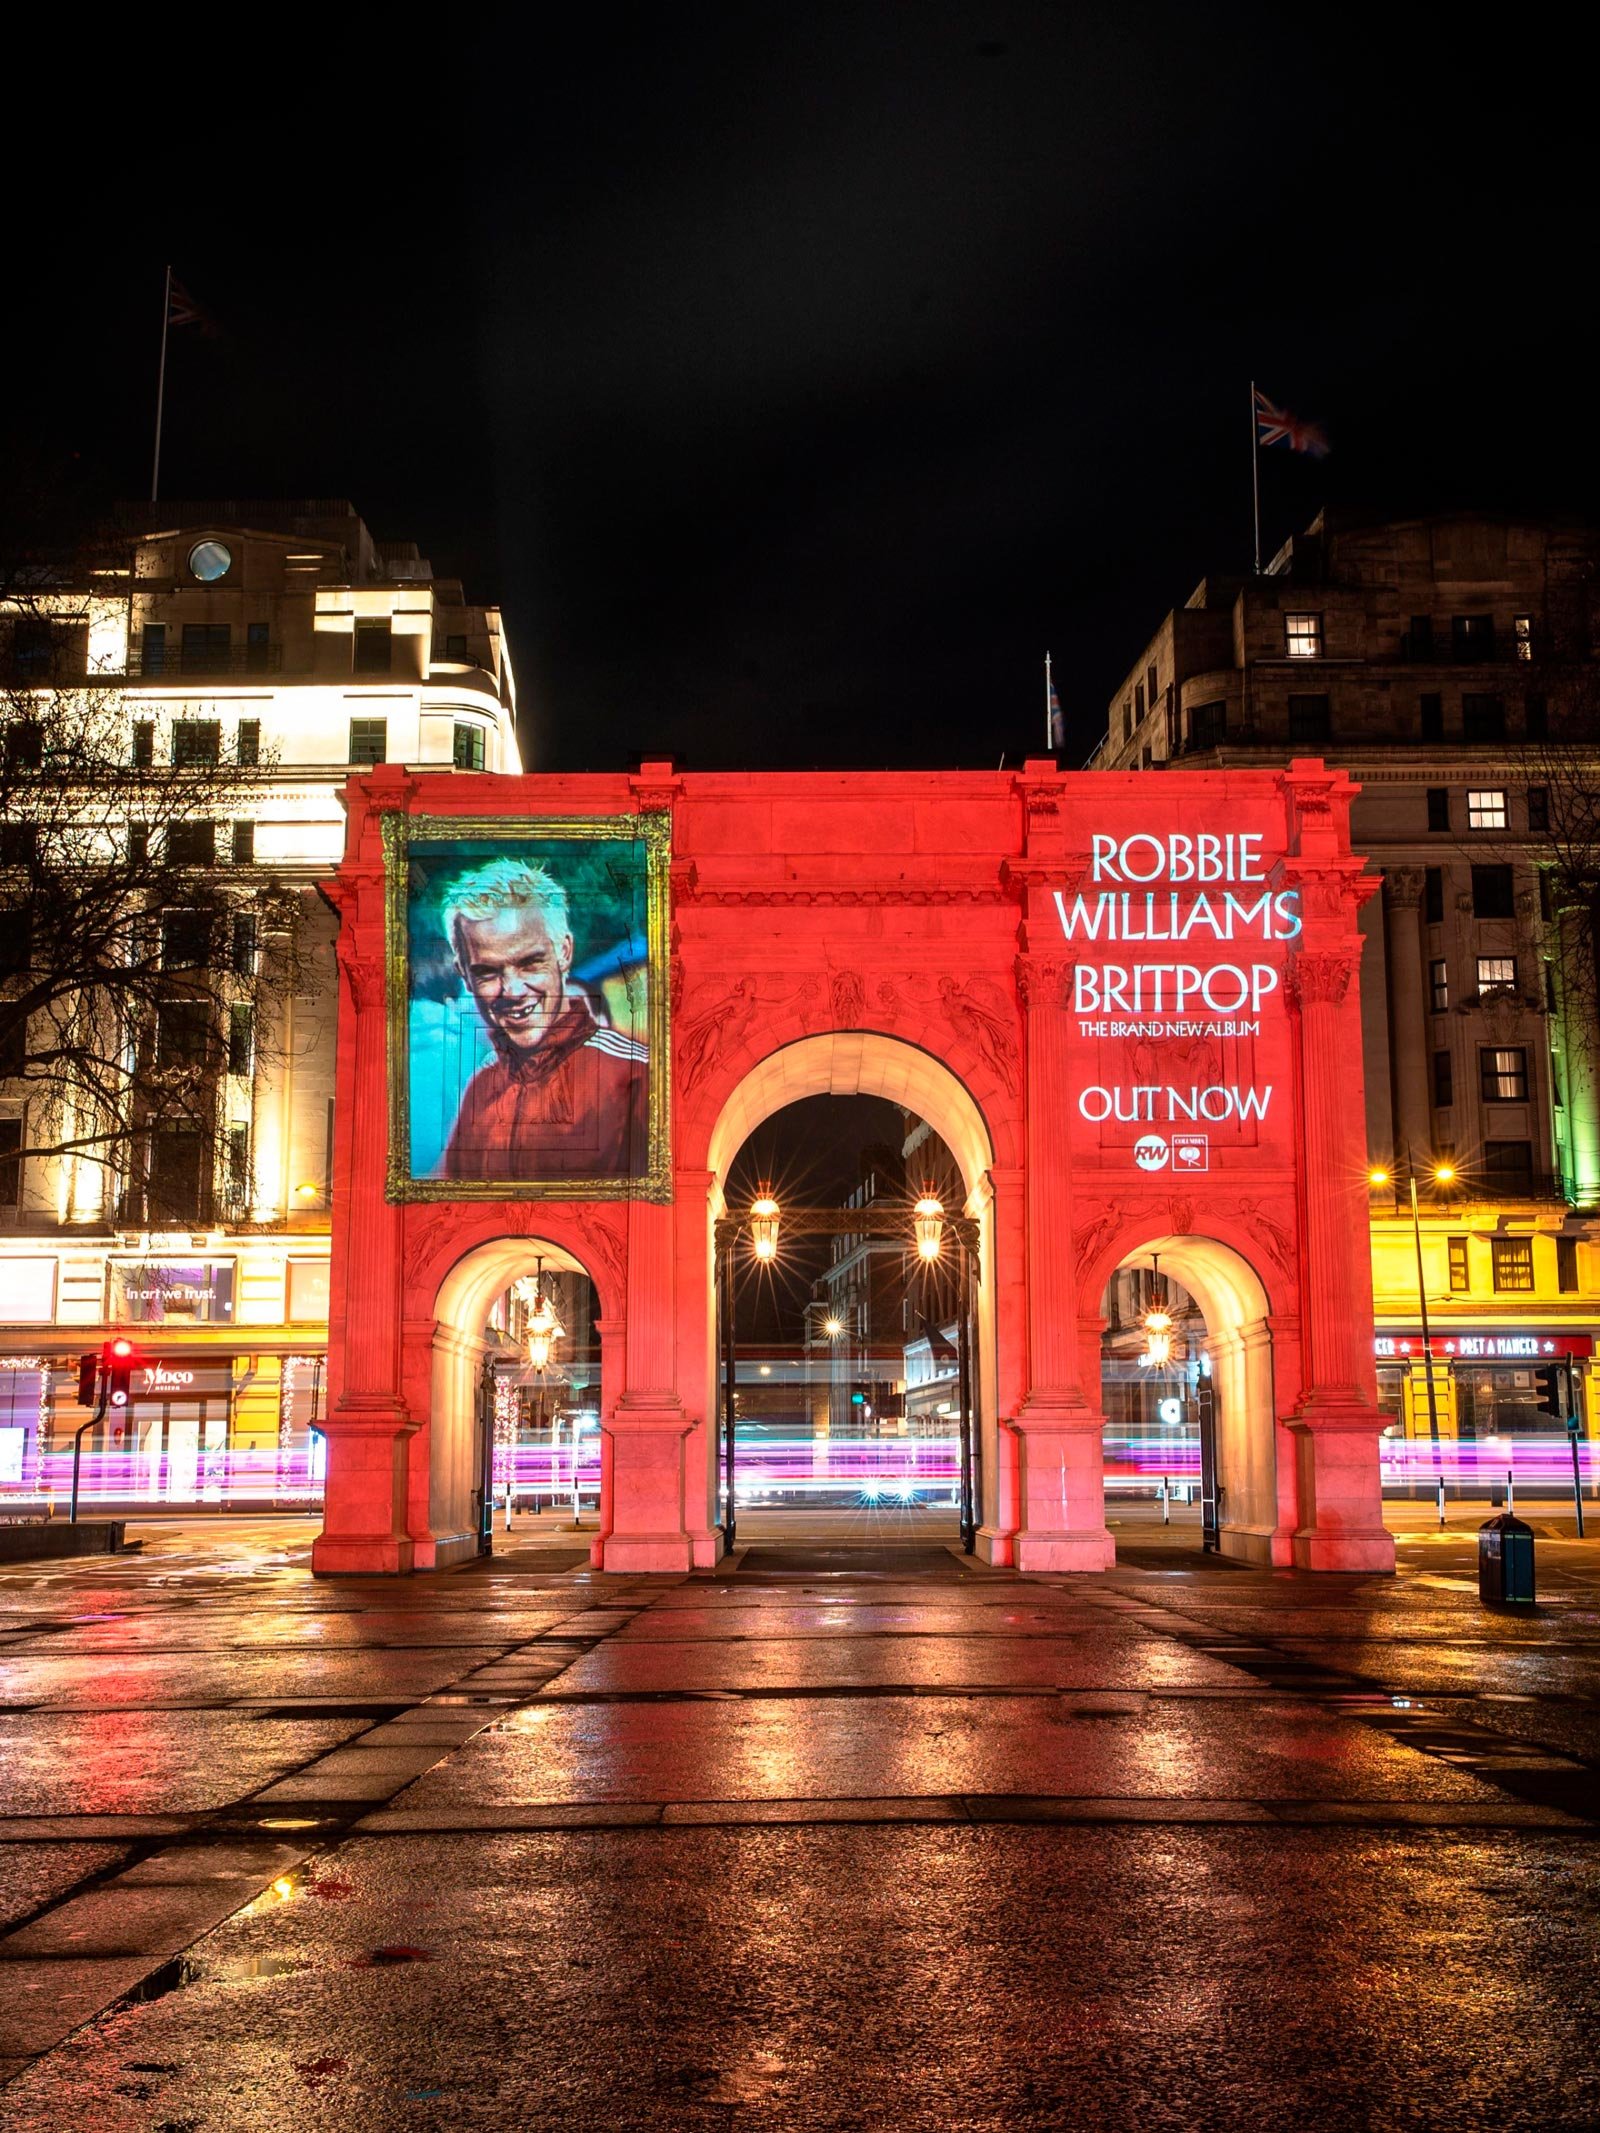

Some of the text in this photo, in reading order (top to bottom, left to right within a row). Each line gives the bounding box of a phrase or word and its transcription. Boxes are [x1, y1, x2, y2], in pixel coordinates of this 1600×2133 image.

[1092, 834, 1266, 882] ROBBIE
[1053, 891, 1302, 941] WILLIAMS
[1074, 964, 1278, 1013] BRITPOP
[1078, 1021, 1260, 1037] THE BRAND NEW ALBUM
[1078, 1086, 1272, 1122] OUT NOW
[1136, 1146, 1168, 1161] RW
[126, 1287, 217, 1300] In art we trust.
[1460, 1338, 1539, 1355] PRET A MANGER
